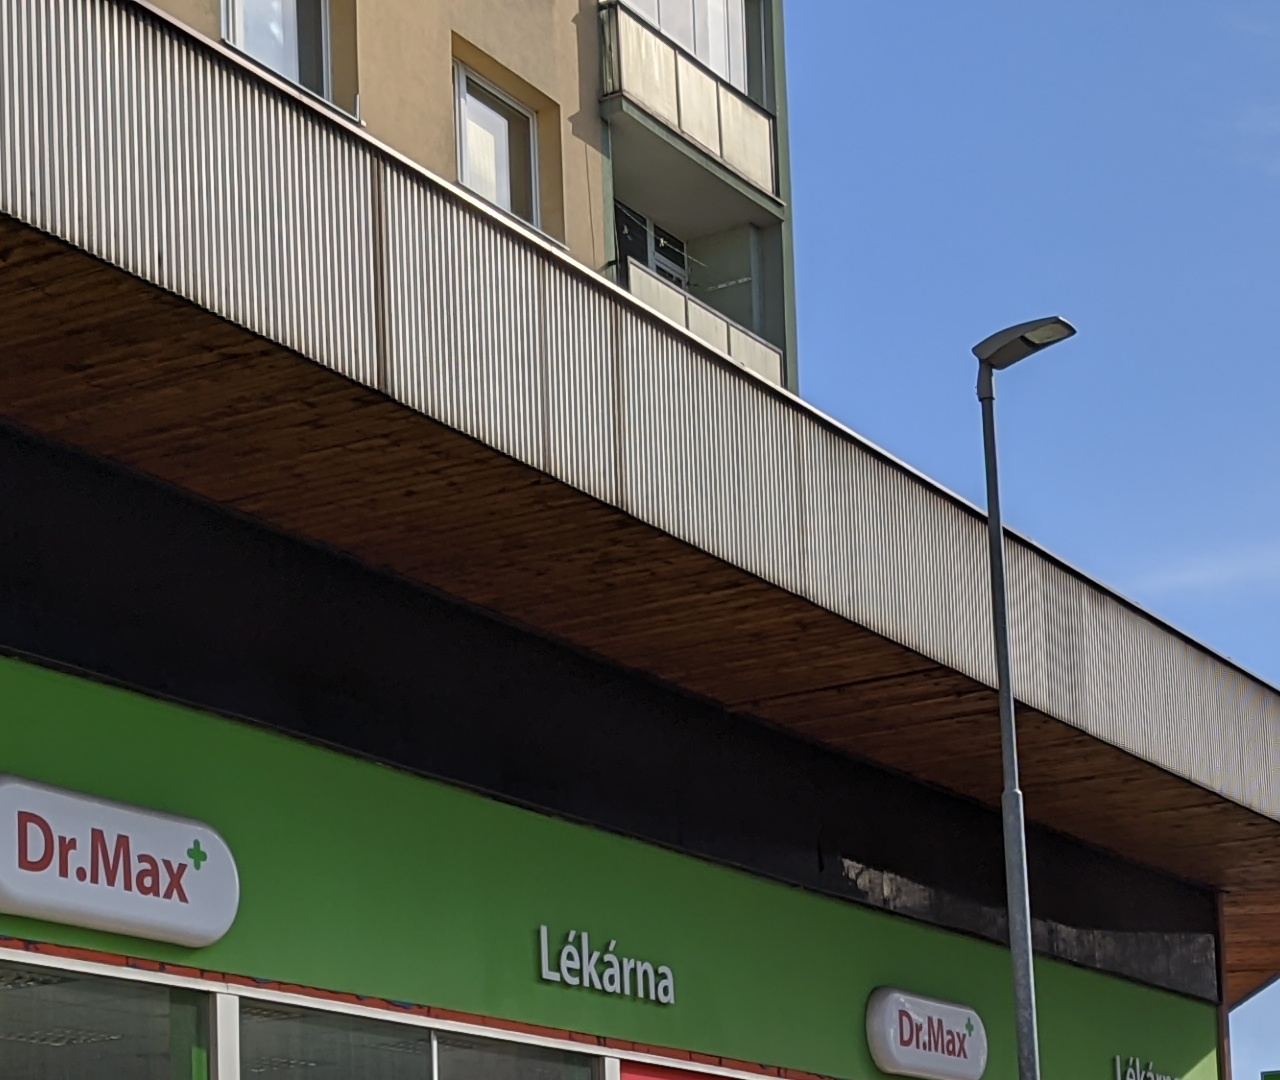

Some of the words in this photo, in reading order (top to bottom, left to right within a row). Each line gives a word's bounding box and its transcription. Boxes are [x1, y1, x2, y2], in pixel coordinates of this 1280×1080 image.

[17, 810, 189, 904] Dr.Max
[540, 924, 675, 1004] Lékárna
[898, 1009, 968, 1059] Dr.Max
